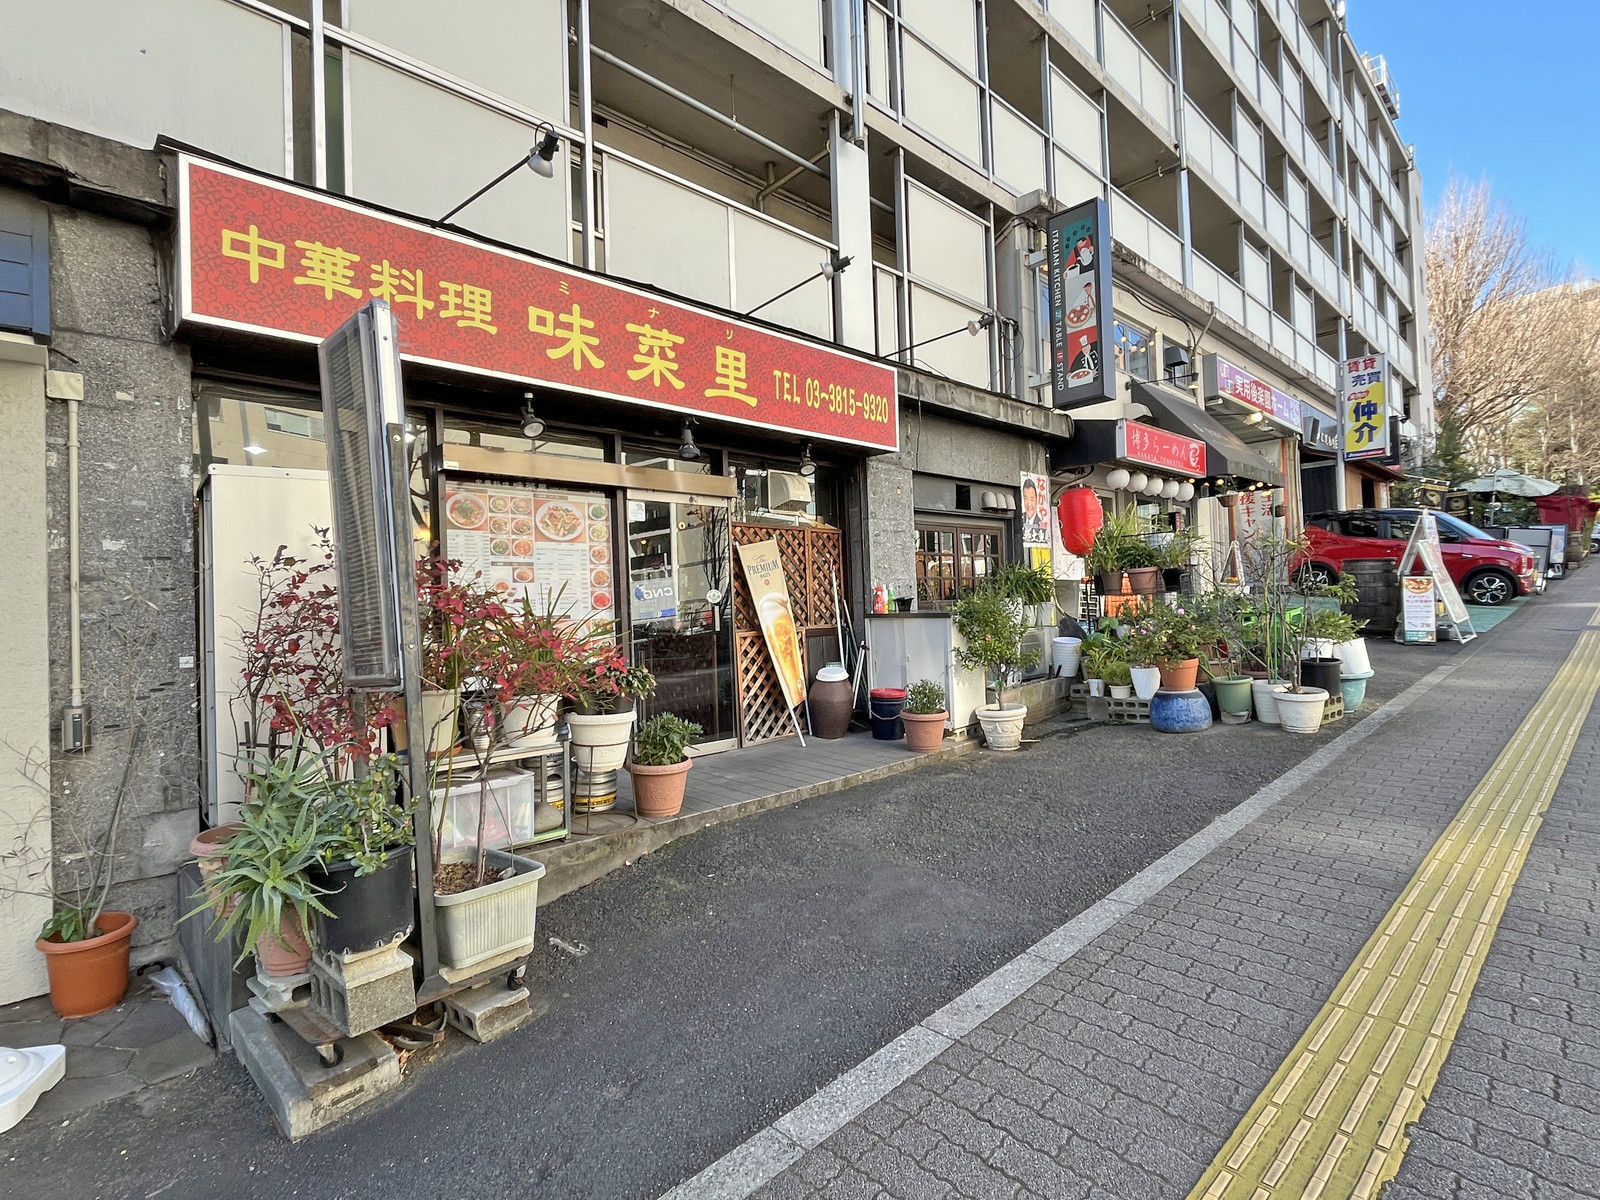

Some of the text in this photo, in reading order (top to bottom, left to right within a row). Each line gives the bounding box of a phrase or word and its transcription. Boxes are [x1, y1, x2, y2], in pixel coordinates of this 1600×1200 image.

[1052, 229, 1060, 266] ITALIAN
[221, 224, 498, 335] 中華料理
[1053, 268, 1062, 307] KITCHEN
[1055, 310, 1062, 319] 2F
[1055, 321, 1063, 347] TABLE
[527, 303, 758, 407] 味菜里
[1347, 357, 1376, 374] 賃貸
[773, 369, 800, 404] TEL
[1056, 362, 1065, 391] STAND
[1351, 371, 1382, 387] 売買
[1352, 400, 1379, 444] 仲介
[1131, 428, 1188, 461] 博多らーめん
[746, 559, 780, 576] PREMIUM
